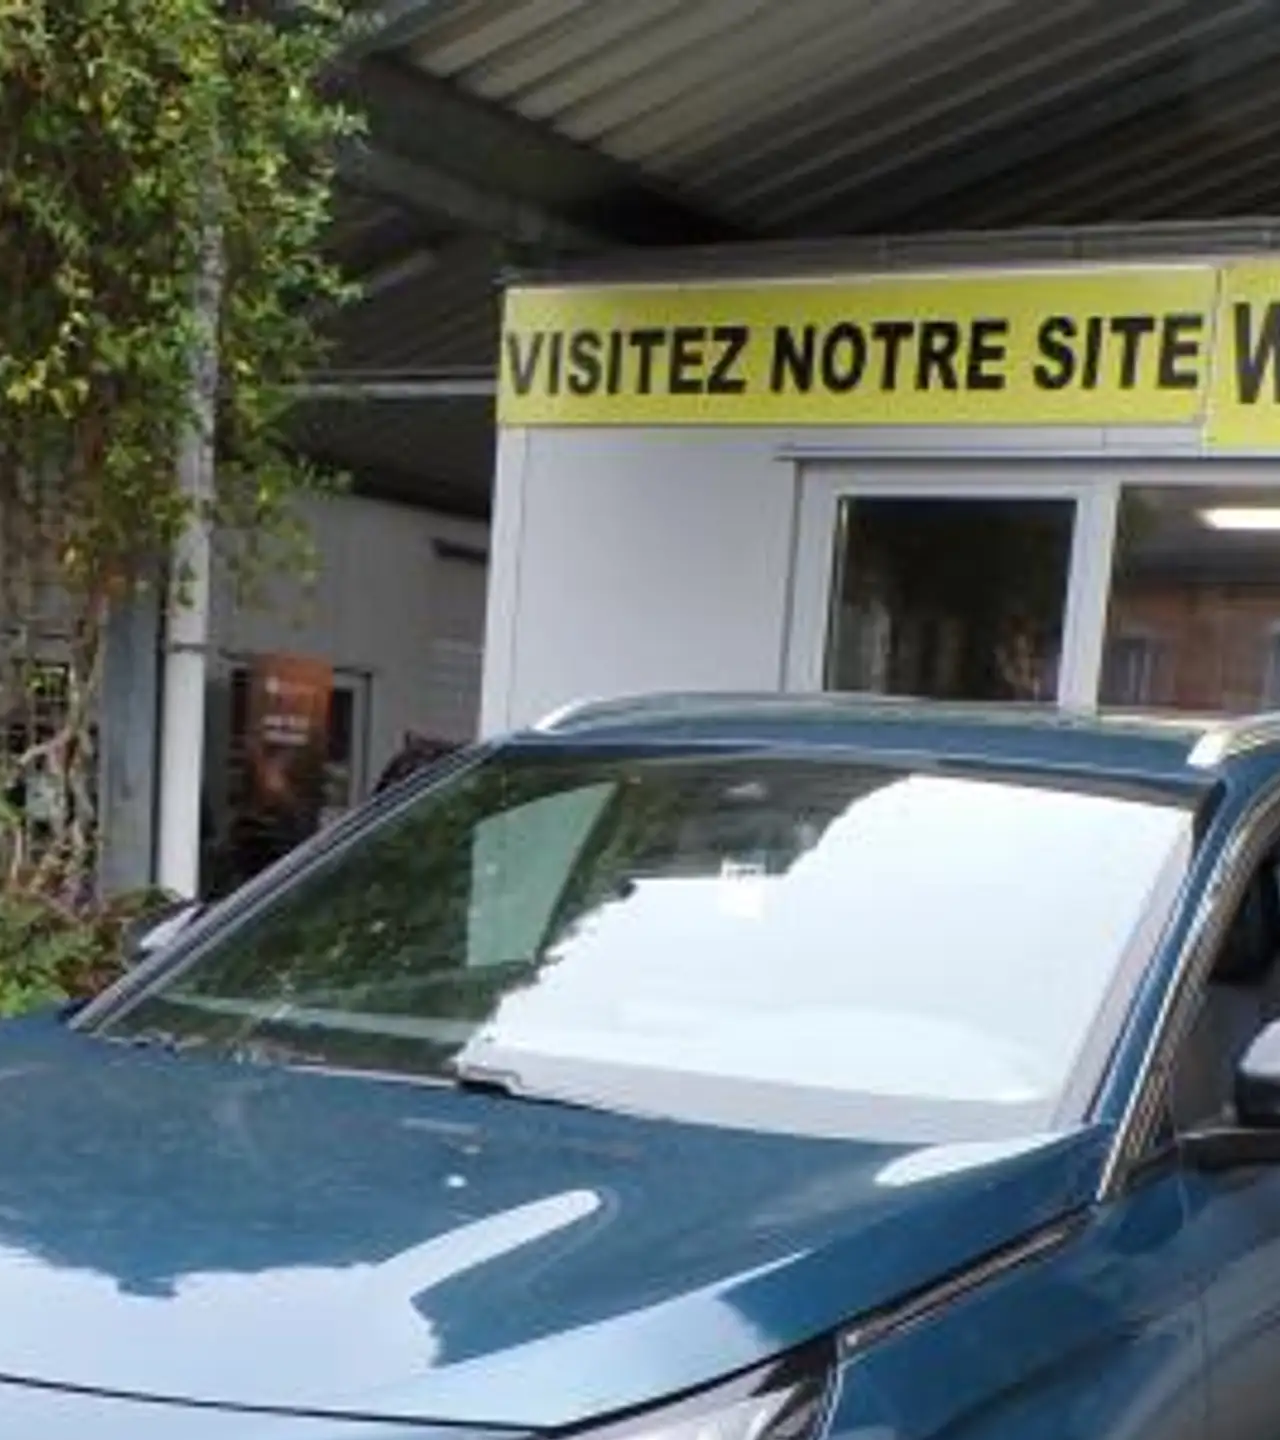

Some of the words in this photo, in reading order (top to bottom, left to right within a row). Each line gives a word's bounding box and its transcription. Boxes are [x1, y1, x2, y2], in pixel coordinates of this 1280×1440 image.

[507, 325, 748, 397] VISITEZ
[768, 320, 1008, 395] NOTRE
[1033, 313, 1204, 391] SITE
